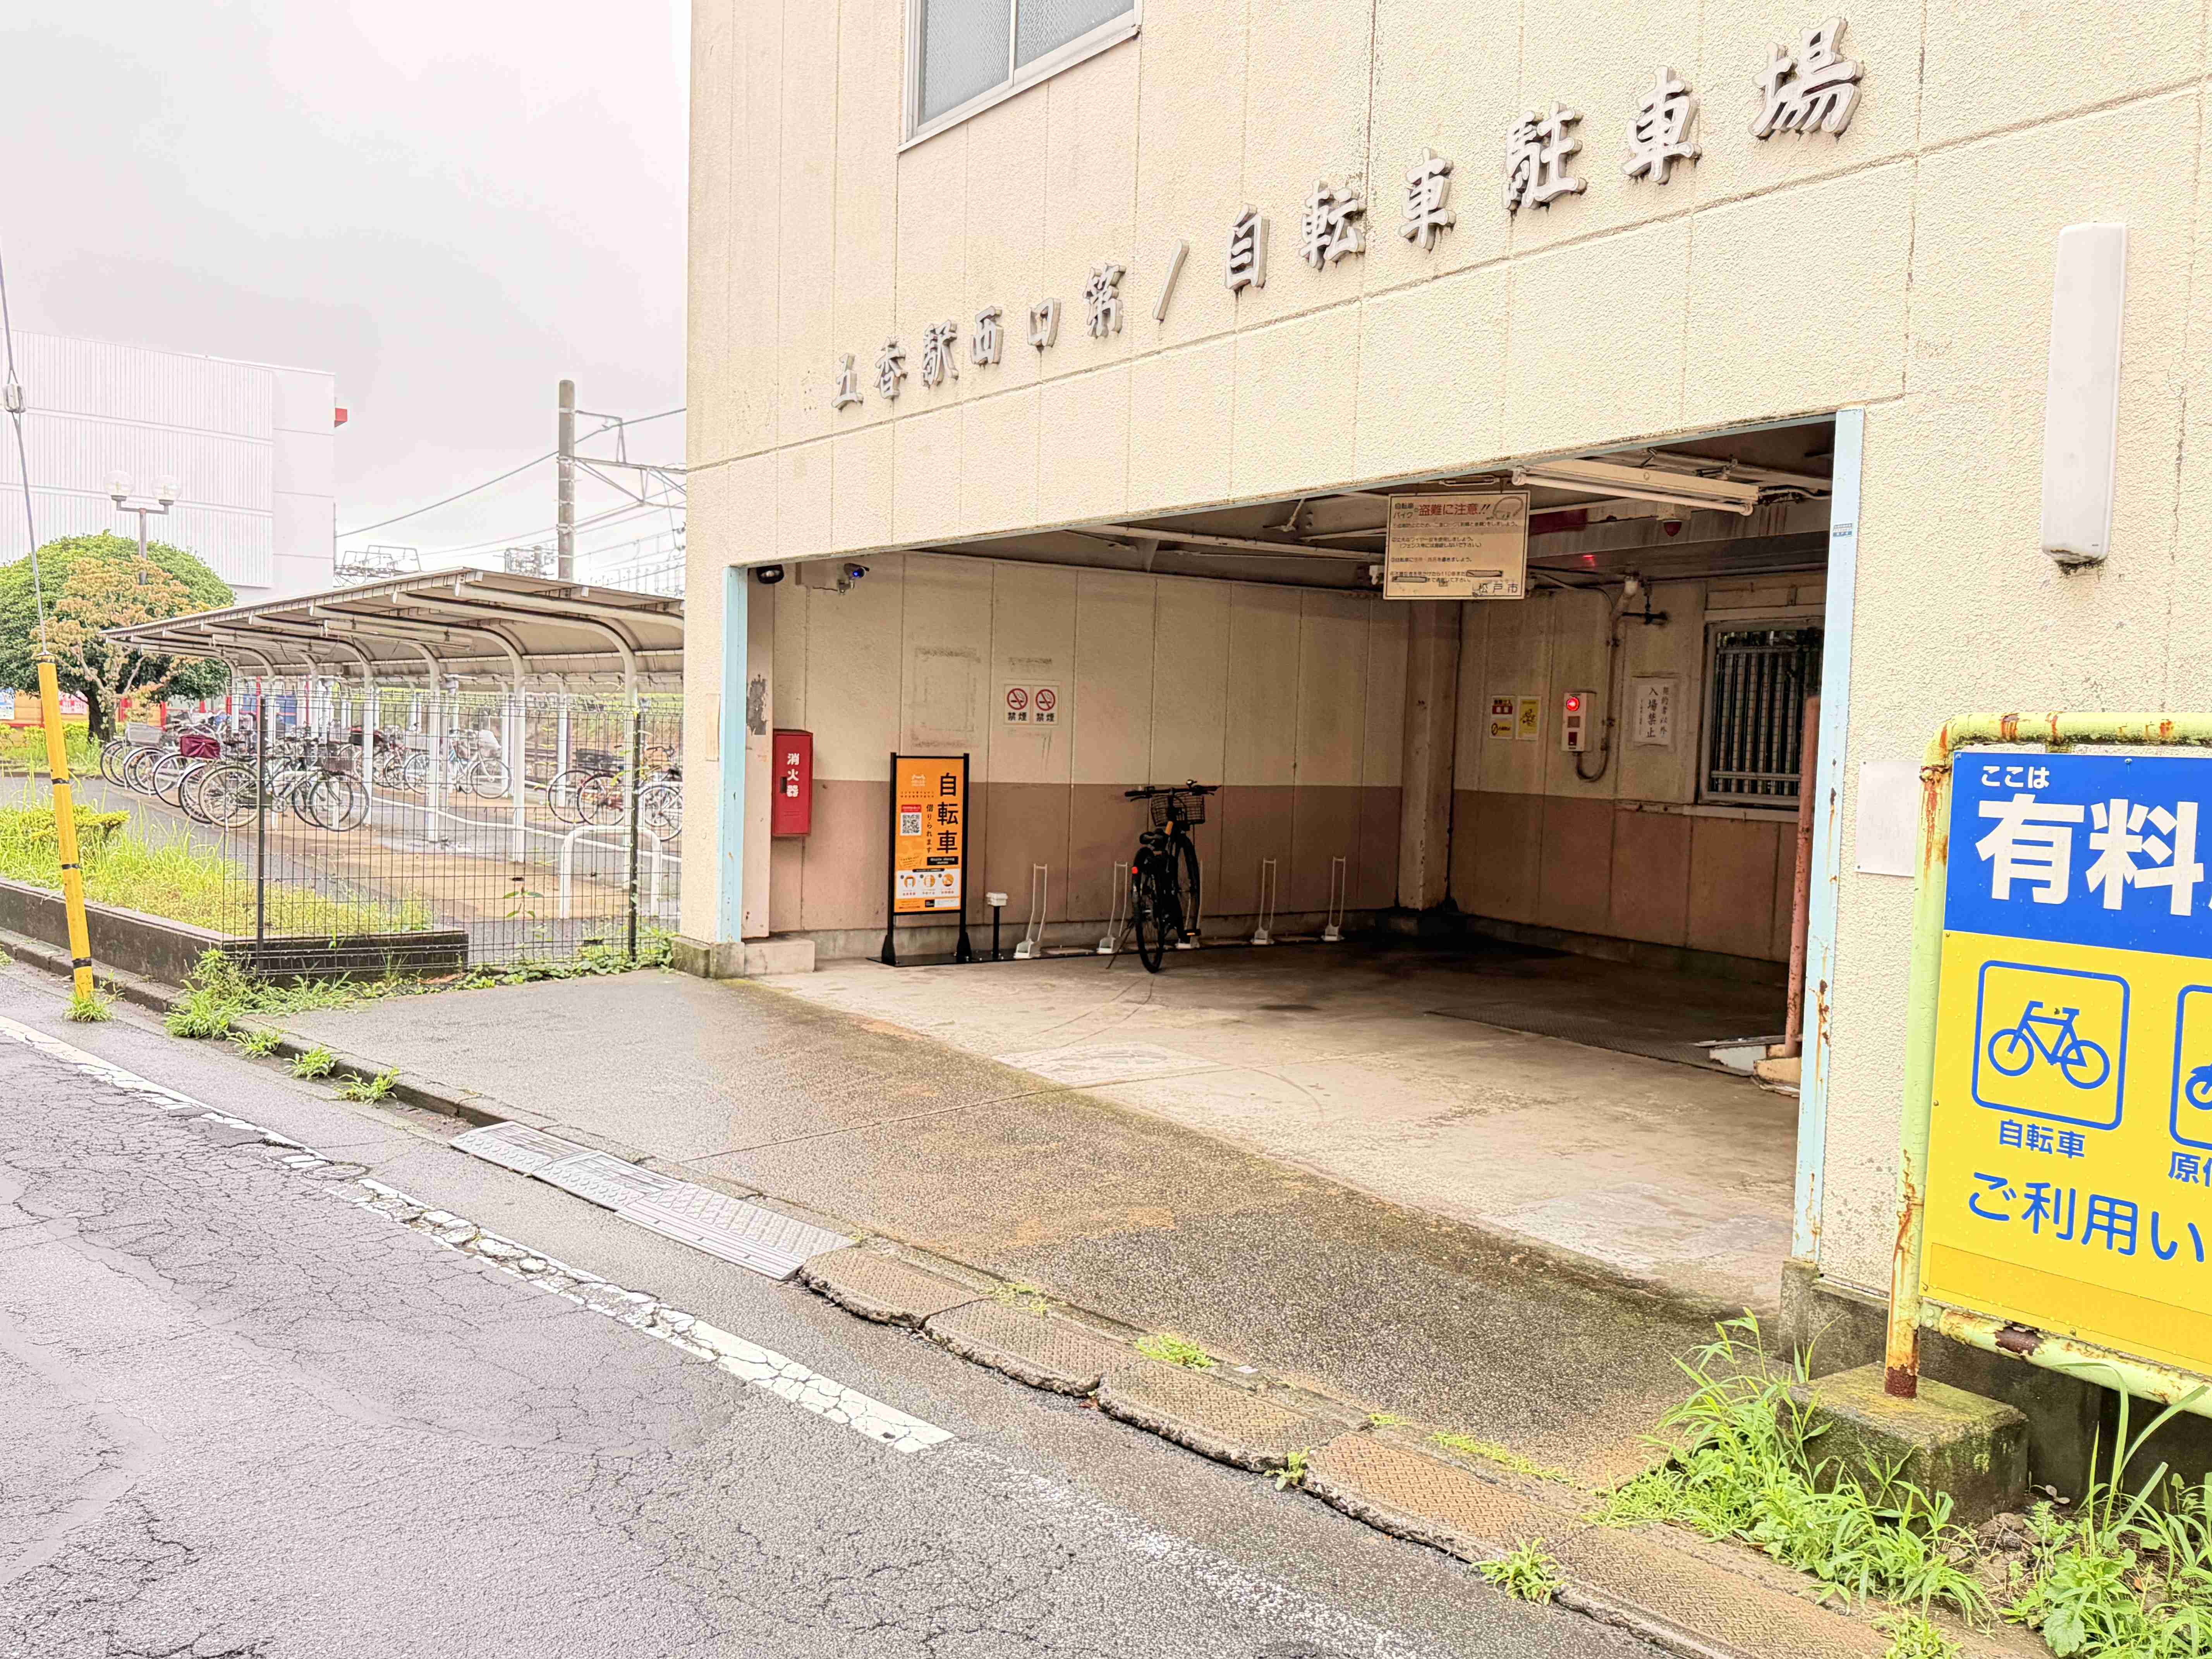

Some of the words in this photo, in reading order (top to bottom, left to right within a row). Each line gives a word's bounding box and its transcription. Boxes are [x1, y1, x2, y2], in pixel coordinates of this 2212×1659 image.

[1479, 582, 1518, 594] 松戸市
[1008, 712, 1027, 721] 禁煙
[1036, 713, 1054, 722] 禁煙
[1647, 687, 1659, 738] 入場禁止
[787, 753, 799, 797] 消火器
[1981, 766, 2050, 789] ここは
[937, 772, 958, 854] 自転車
[1975, 793, 2212, 916] 有料
[1999, 1120, 2086, 1159] 自転車
[1969, 1172, 2204, 1262] ご利用い
